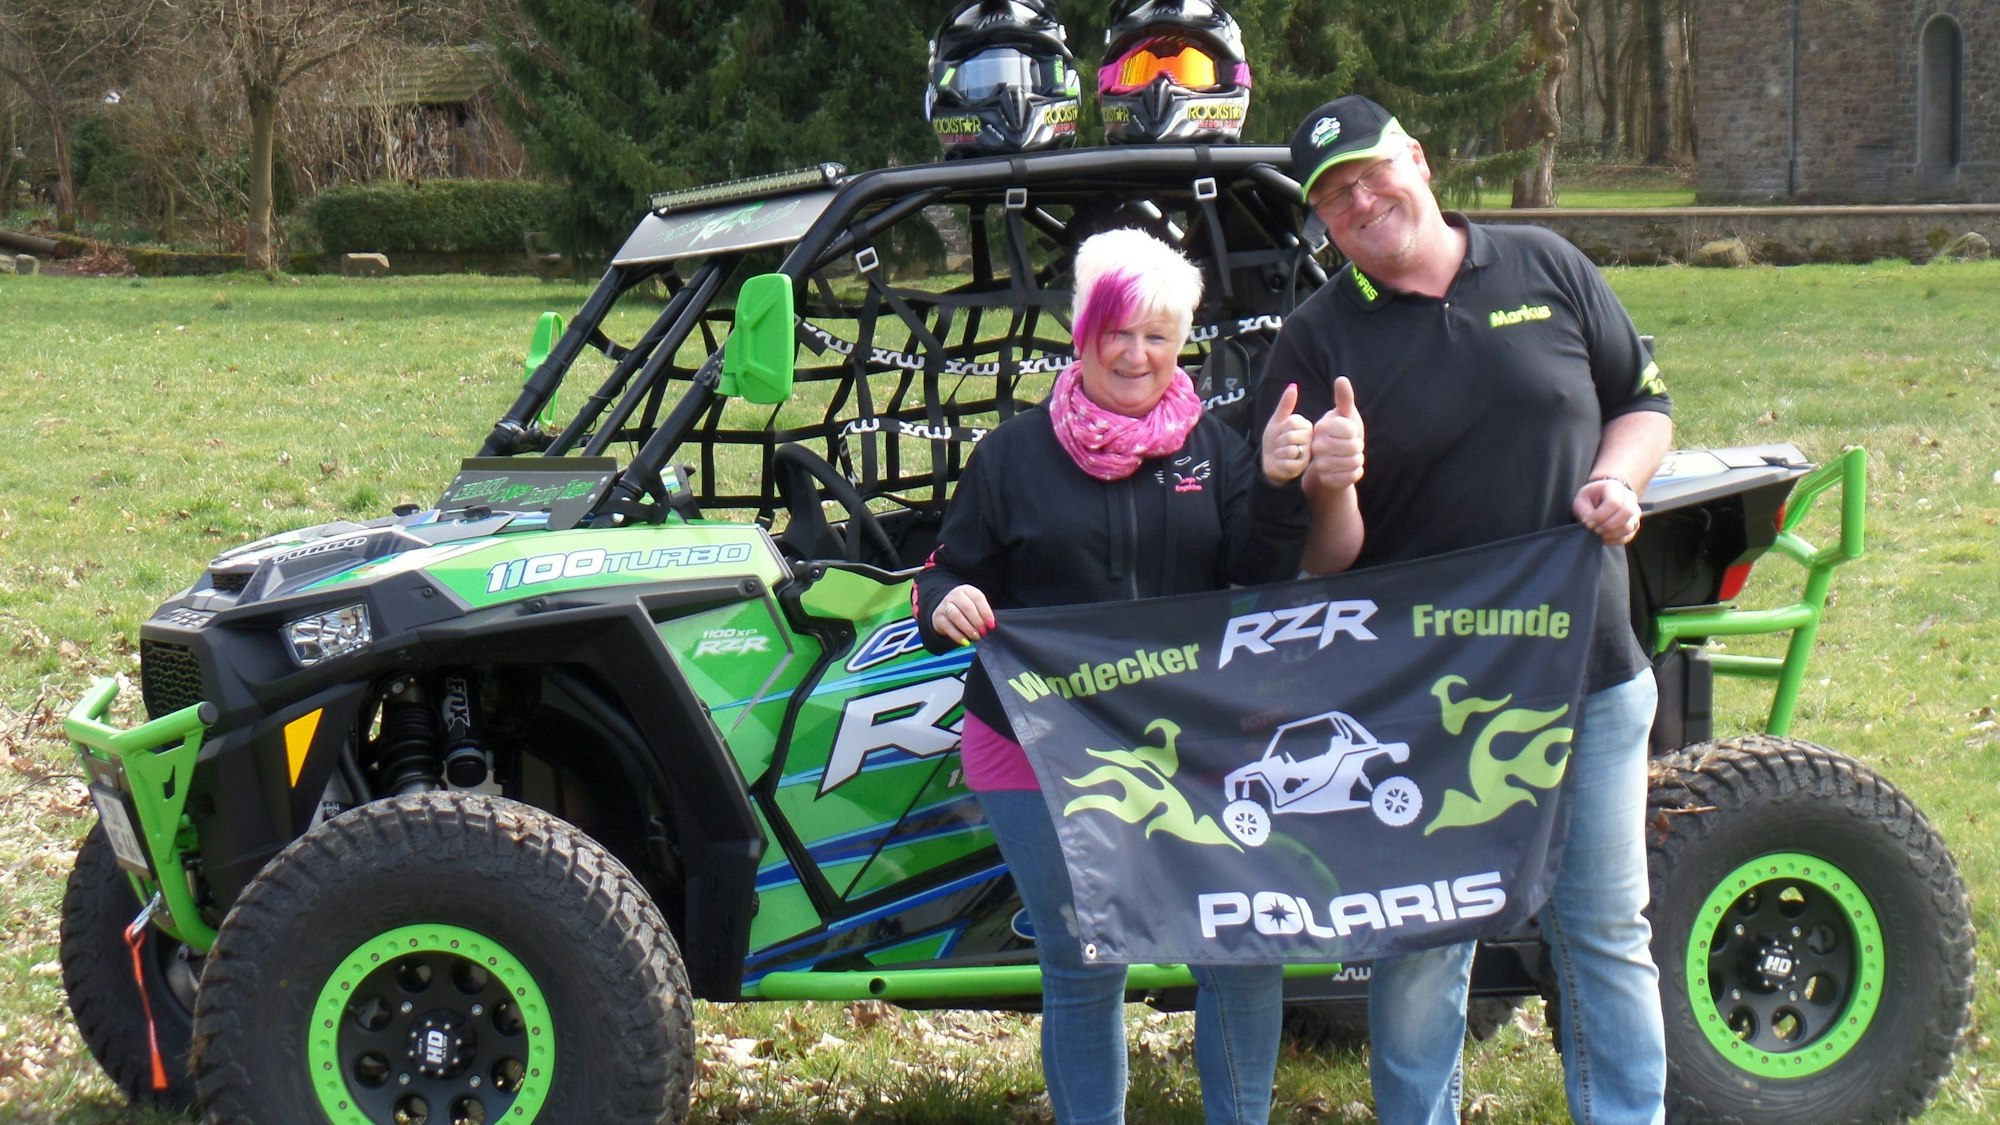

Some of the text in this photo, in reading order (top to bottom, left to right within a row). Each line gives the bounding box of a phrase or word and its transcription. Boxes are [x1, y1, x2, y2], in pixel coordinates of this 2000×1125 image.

[1490, 303, 1552, 327] Markus
[692, 635, 772, 660] RZR
[1007, 600, 1571, 703] Wndecker RZR Freunde
[1198, 871, 1507, 939] POLARIS
[1764, 955, 1792, 974] HD
[426, 1030, 444, 1064] HD
